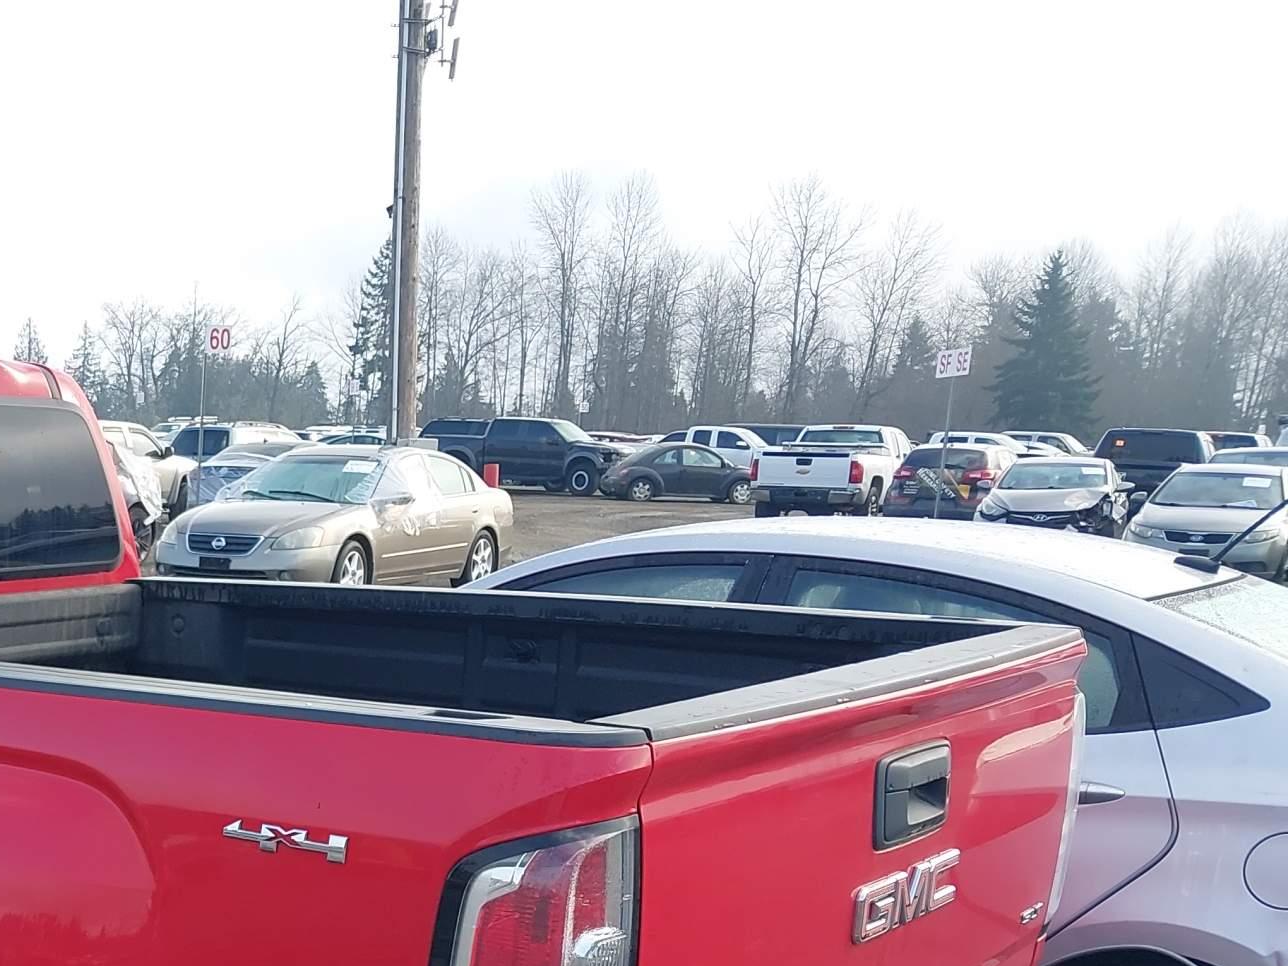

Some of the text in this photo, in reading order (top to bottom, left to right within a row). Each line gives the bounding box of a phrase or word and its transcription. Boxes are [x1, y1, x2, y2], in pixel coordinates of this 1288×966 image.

[210, 327, 231, 350] 60
[939, 350, 969, 375] SF SE
[851, 848, 961, 945] GMC
